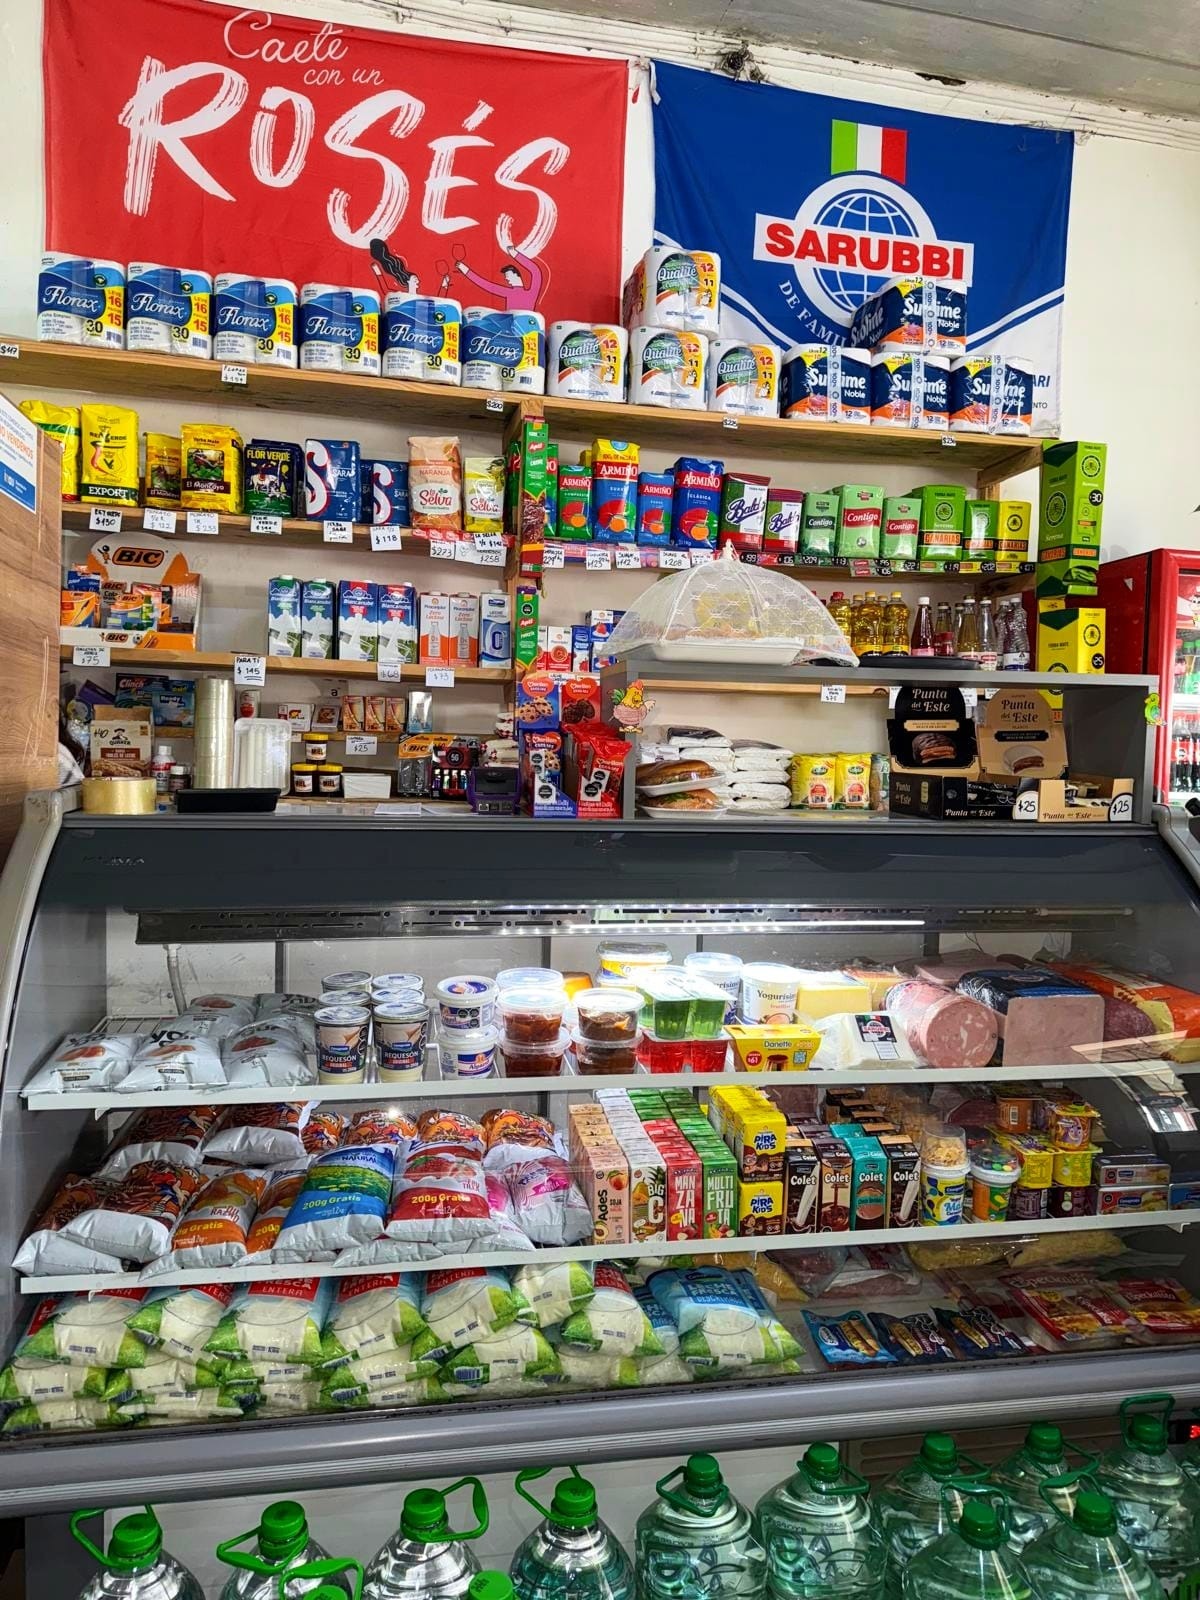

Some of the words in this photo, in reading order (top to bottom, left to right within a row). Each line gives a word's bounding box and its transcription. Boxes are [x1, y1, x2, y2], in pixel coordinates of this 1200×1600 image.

[223, 11, 348, 64] Caete
[303, 67, 346, 86] con
[352, 69, 385, 86] un
[118, 55, 571, 259] ROSÉS
[765, 222, 964, 280] SARUBBI
[701, 263, 714, 273] 12
[704, 278, 714, 287] 11
[43, 286, 98, 312] Florax
[779, 279, 797, 309] DE
[109, 296, 121, 308] 16
[129, 292, 184, 318] Florax
[194, 303, 207, 315] 16
[108, 313, 121, 327] 15
[219, 307, 268, 331] Florax
[279, 313, 291, 325] 16
[86, 320, 103, 334] 30
[194, 320, 207, 333] 15
[306, 316, 356, 342] Florax
[366, 324, 377, 334] 16
[172, 327, 189, 339] 30
[278, 331, 291, 343] 15
[389, 324, 437, 349] Florax
[446, 332, 457, 343] 16
[258, 338, 274, 351] 30
[365, 340, 377, 352] 15
[468, 337, 519, 361] Florax
[603, 339, 618, 349] 12
[345, 348, 361, 360] 30
[445, 348, 457, 359] 15
[427, 355, 442, 367] 30
[606, 355, 617, 364] 11
[689, 359, 699, 367] 11
[760, 357, 773, 366] 12
[501, 368, 515, 379] 60
[763, 371, 772, 379] 11
[844, 389, 866, 400] Noble
[926, 394, 946, 404] Noble
[845, 410, 853, 418] 12
[926, 415, 934, 423] 12
[247, 450, 266, 459] FLOR
[266, 452, 291, 462] VERDE
[333, 469, 354, 478] SARA
[600, 464, 638, 477] ARMIÑO
[563, 477, 591, 487] ARMIÑO
[683, 472, 720, 488] ARMIÑO
[89, 486, 127, 498] EXPORT
[644, 485, 672, 495] ARMIÑO
[420, 490, 452, 507] Selva
[847, 512, 879, 522] Contigo
[808, 518, 833, 528] Contigo
[376, 535, 398, 544] $118
[924, 533, 961, 544] CANARIAS
[115, 547, 163, 565] BIC
[431, 546, 452, 557] $273
[106, 633, 127, 641] BIC
[82, 656, 99, 665] $75
[245, 667, 261, 675] 145
[120, 680, 145, 688] Clinch
[912, 689, 947, 699] Punta
[911, 702, 922, 711] del
[923, 702, 950, 712] Este
[1001, 700, 1034, 710] Punta
[1012, 713, 1038, 722] Este
[354, 745, 369, 753] $25
[1018, 801, 1036, 813] $25
[1112, 800, 1130, 813] $25
[945, 809, 968, 817] Punta
[978, 809, 996, 817] Este
[1043, 812, 1065, 820] Punta
[322, 1054, 357, 1062] REQUESÓN
[384, 1051, 419, 1059] REQUESÓN
[790, 1175, 816, 1186] Colet
[824, 1173, 851, 1183] Colet
[859, 1172, 884, 1182] Colet
[893, 1171, 920, 1181] Colet
[675, 1176, 696, 1191] MAN
[707, 1175, 734, 1191] MULTI
[648, 1184, 665, 1196] BIG
[302, 1199, 328, 1211] 200g
[328, 1195, 361, 1205] Gratis
[411, 1195, 437, 1205] 200g
[439, 1193, 471, 1202] Gratis
[676, 1190, 696, 1209] ZA
[707, 1191, 734, 1210] FRU
[598, 1189, 608, 1221] Ades
[648, 1196, 665, 1224] C
[679, 1209, 696, 1228] NA
[717, 1210, 731, 1225] TA
[189, 1221, 223, 1232] Gratis
[262, 1286, 304, 1296] ENTERA
